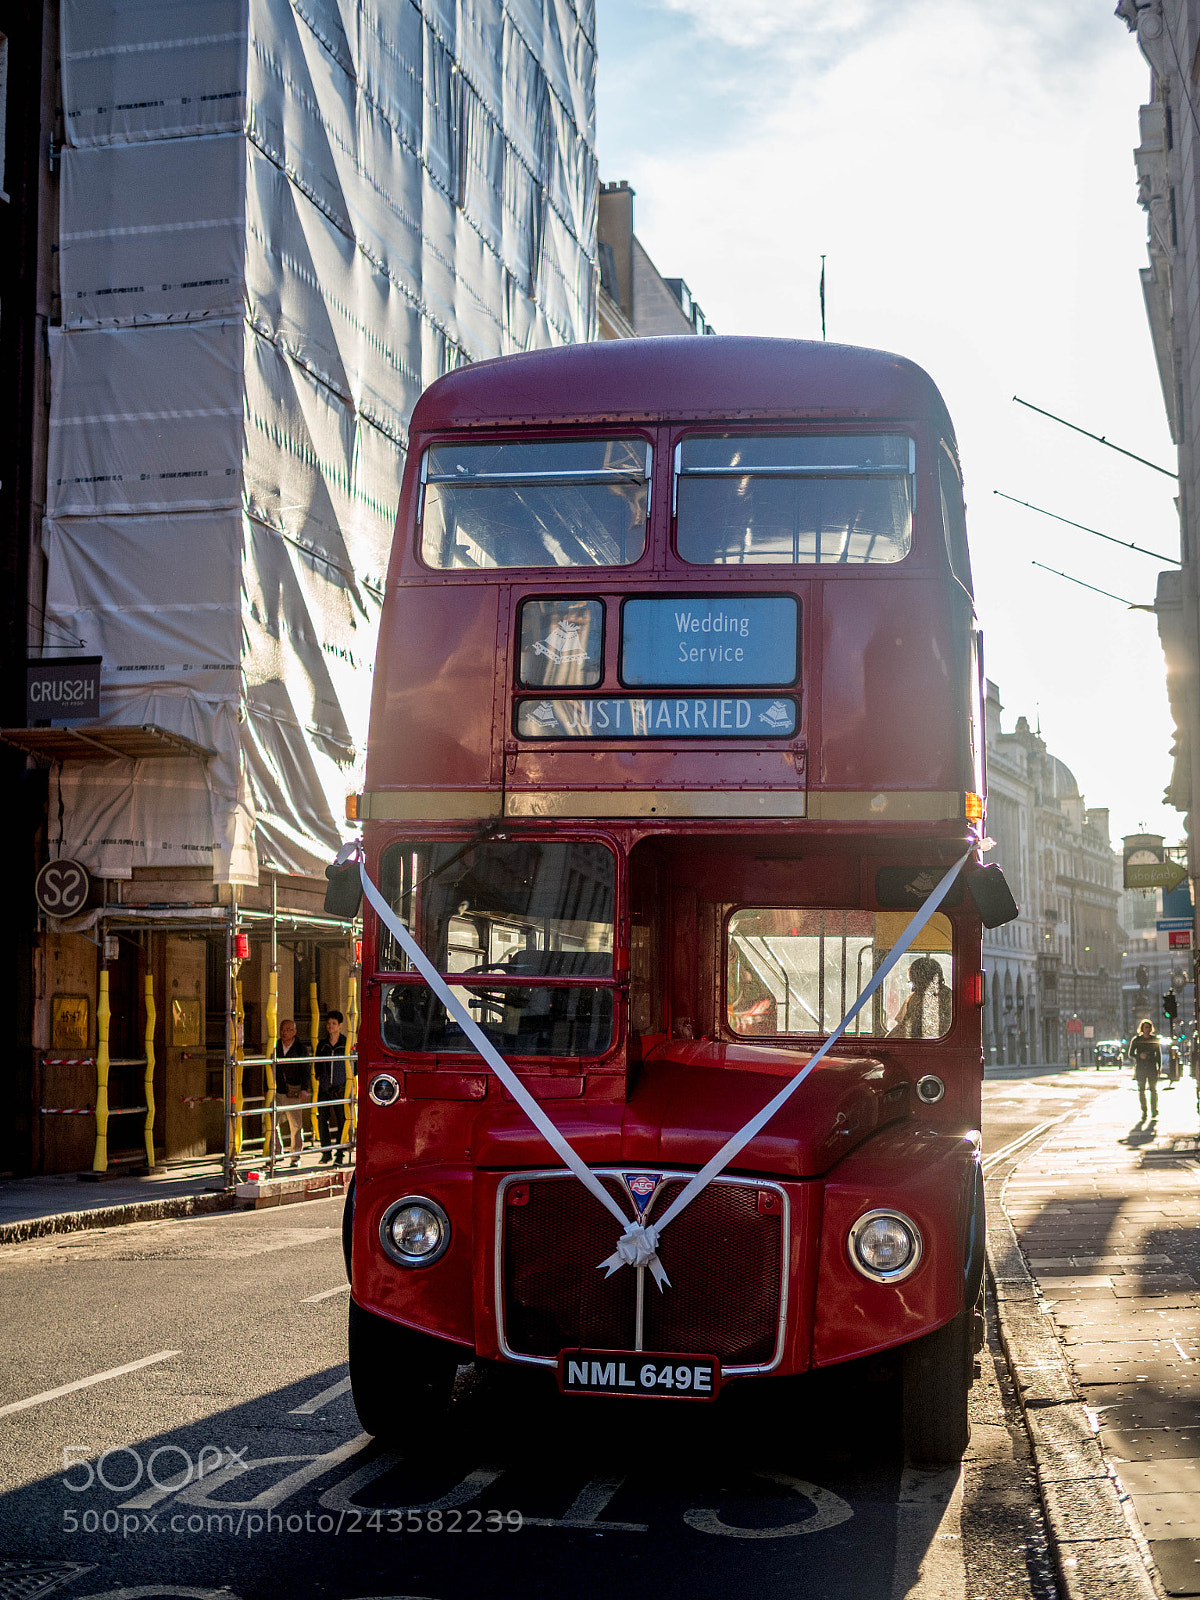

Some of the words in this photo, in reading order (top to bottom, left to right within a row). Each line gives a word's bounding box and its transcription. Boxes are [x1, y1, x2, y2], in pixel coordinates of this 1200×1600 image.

[674, 612, 750, 637] Wedding
[678, 641, 744, 662] Service
[30, 679, 95, 702] CRUSSH
[568, 700, 628, 729] JUST
[643, 700, 751, 729] MARRIED
[631, 1182, 653, 1190] AEC
[568, 1361, 636, 1387] NML
[639, 1364, 712, 1391] 649E
